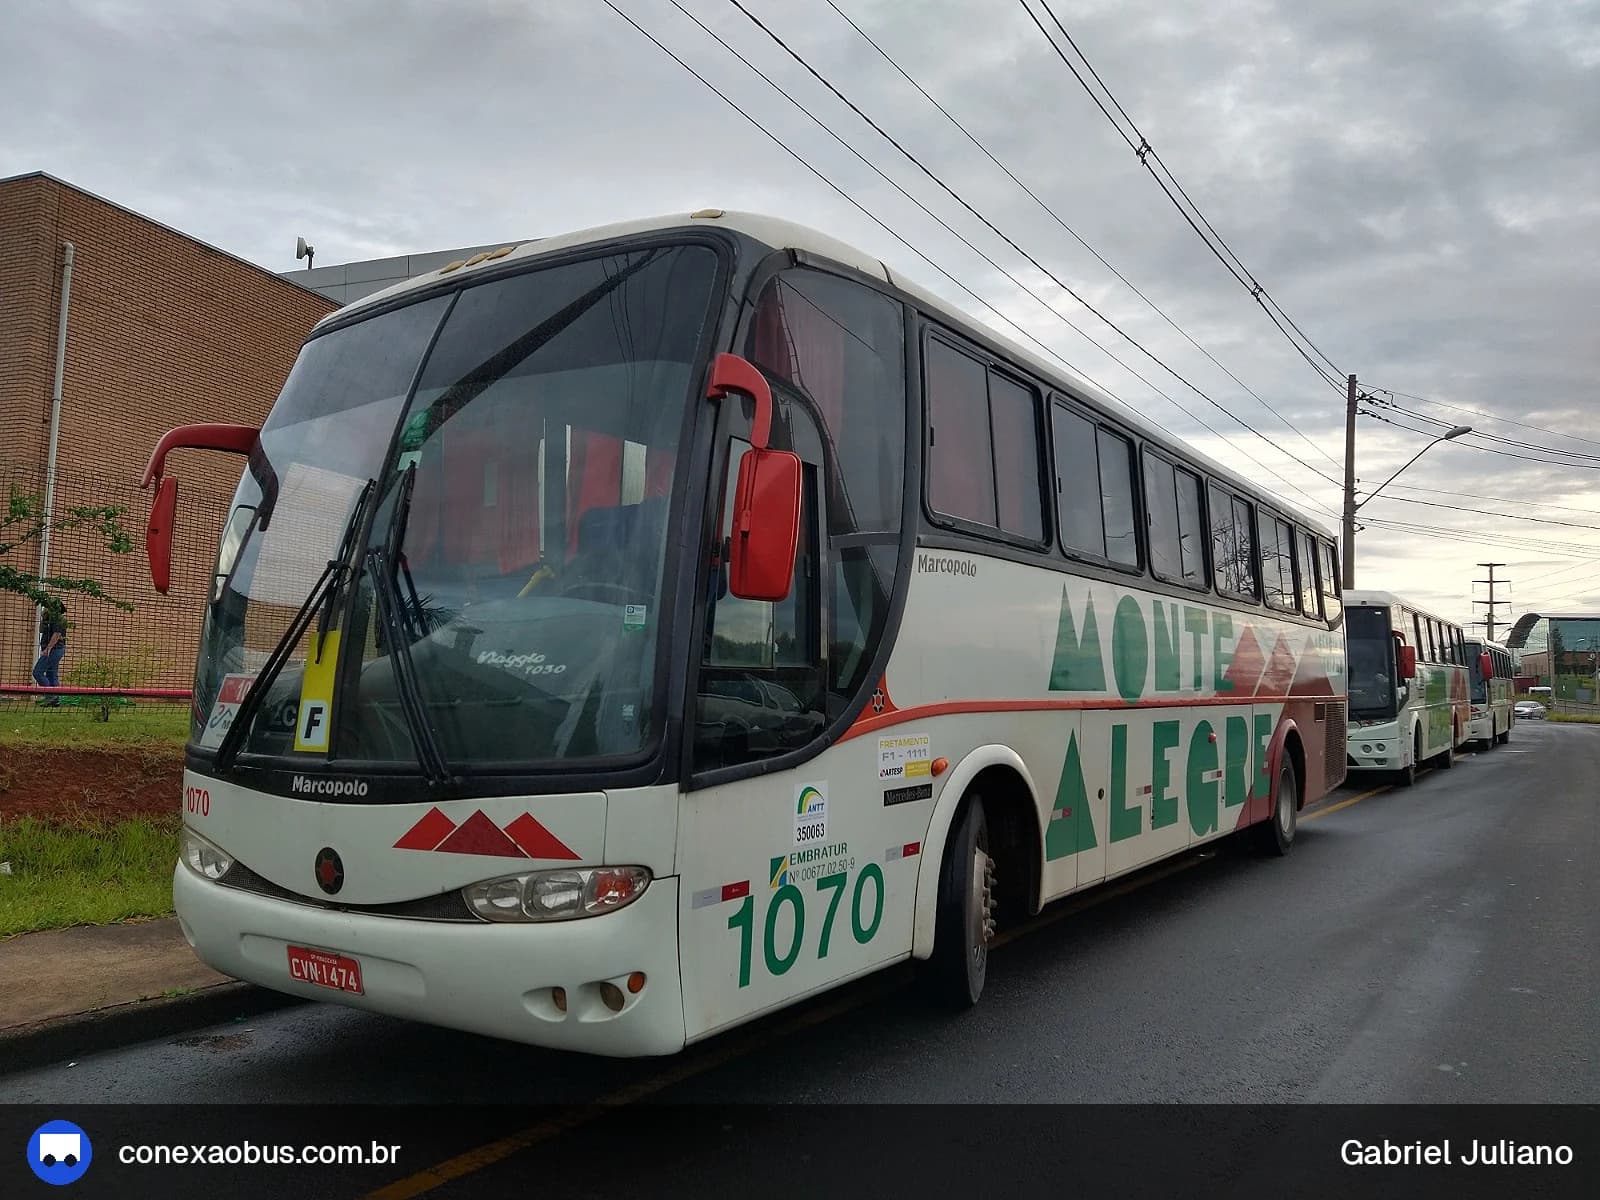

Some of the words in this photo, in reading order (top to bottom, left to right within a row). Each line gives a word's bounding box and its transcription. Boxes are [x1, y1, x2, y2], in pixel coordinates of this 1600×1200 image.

[917, 554, 977, 577] Marcopolo
[1048, 581, 1236, 705] MONTE
[304, 706, 324, 739] F
[880, 737, 929, 749] FRETAMENTO
[882, 752, 895, 761] F1
[906, 748, 928, 759] 1111
[292, 775, 368, 797] Marcopolo
[1045, 713, 1273, 863] ALEGRE
[185, 786, 210, 817] 1070
[807, 802, 825, 813] ANTT
[796, 823, 825, 842] 350063
[790, 843, 848, 866] EMBRATUR
[728, 863, 885, 989] 1070
